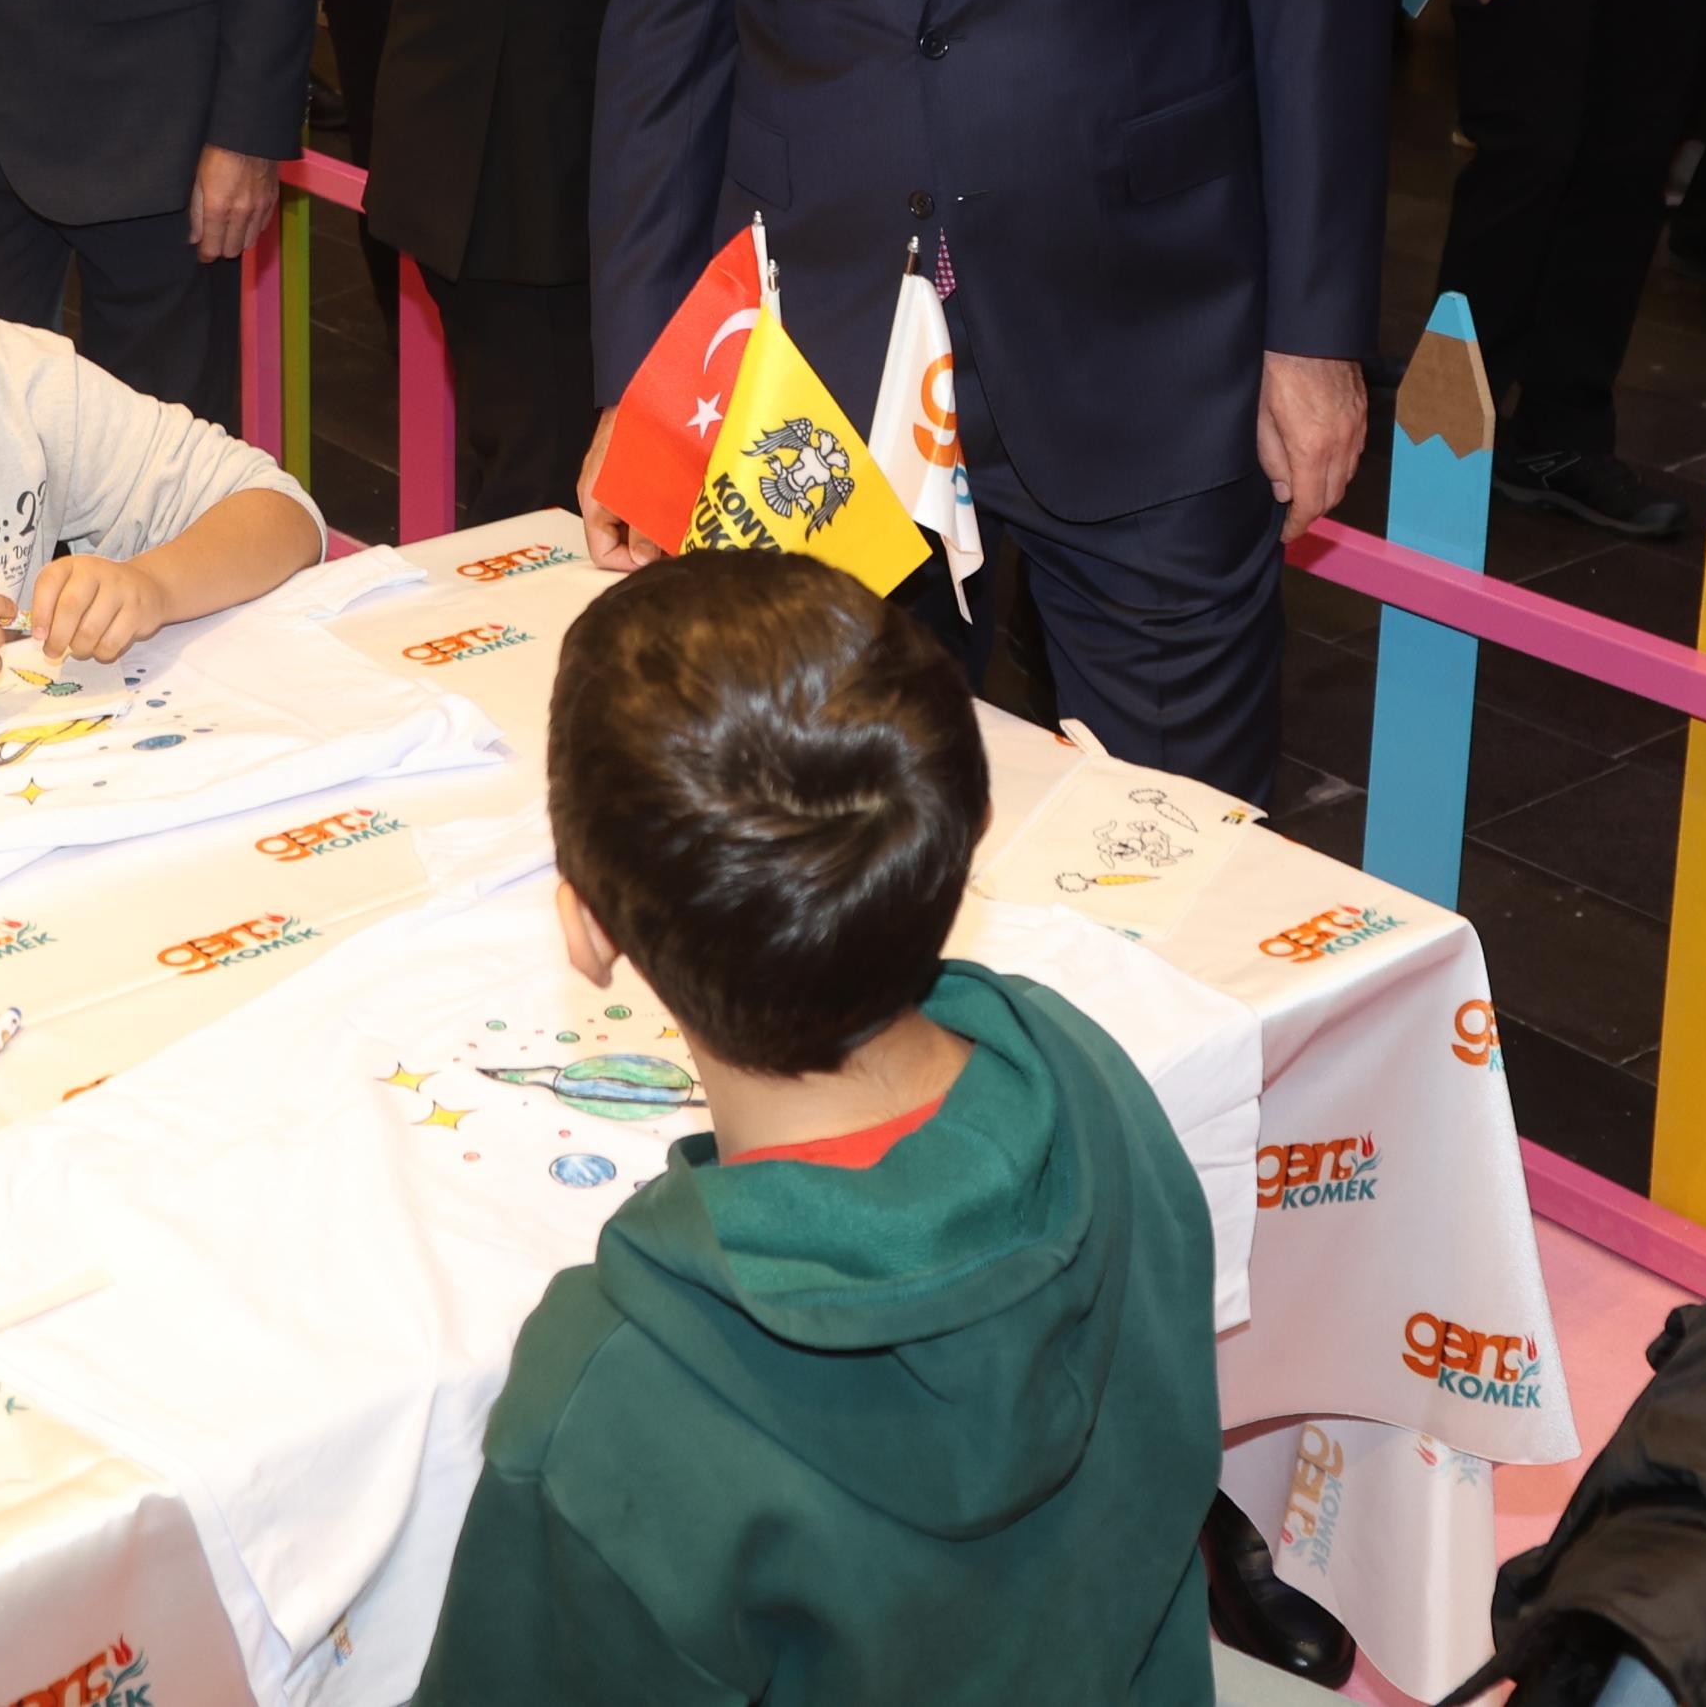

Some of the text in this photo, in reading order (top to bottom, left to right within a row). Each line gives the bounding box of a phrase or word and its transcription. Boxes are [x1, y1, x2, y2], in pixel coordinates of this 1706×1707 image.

[503, 552, 581, 577] KOMEK
[451, 632, 537, 661] KOMEK
[310, 818, 410, 855] KOMEK
[214, 926, 324, 967] KOMEK
[1321, 915, 1408, 955] KOMEK
[1281, 1178, 1378, 1210] KOMEK
[1437, 1366, 1542, 1409] KOMEK
